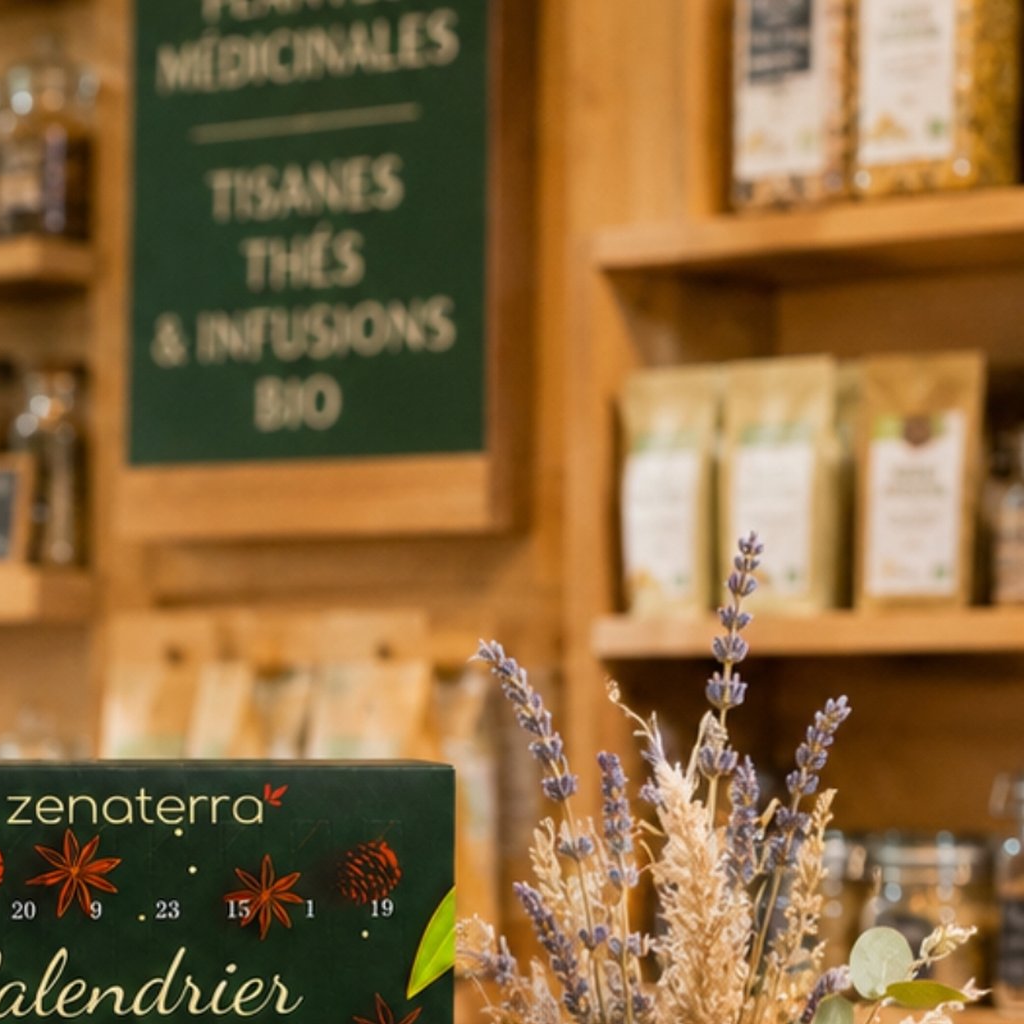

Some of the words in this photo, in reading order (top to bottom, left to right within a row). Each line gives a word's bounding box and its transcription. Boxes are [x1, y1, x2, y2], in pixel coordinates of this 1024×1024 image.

[207, 153, 404, 222] TISANES
[241, 221, 365, 291] THÉS
[150, 312, 189, 368] &
[195, 295, 456, 366] INFUSIONS
[254, 373, 342, 432] BIO
[6, 788, 263, 825] zenaterra
[11, 900, 36, 920] 20
[89, 901, 102, 919] 9
[155, 900, 181, 919] 23
[227, 900, 250, 919] 15
[305, 899, 315, 918] 1
[371, 899, 394, 918] 19
